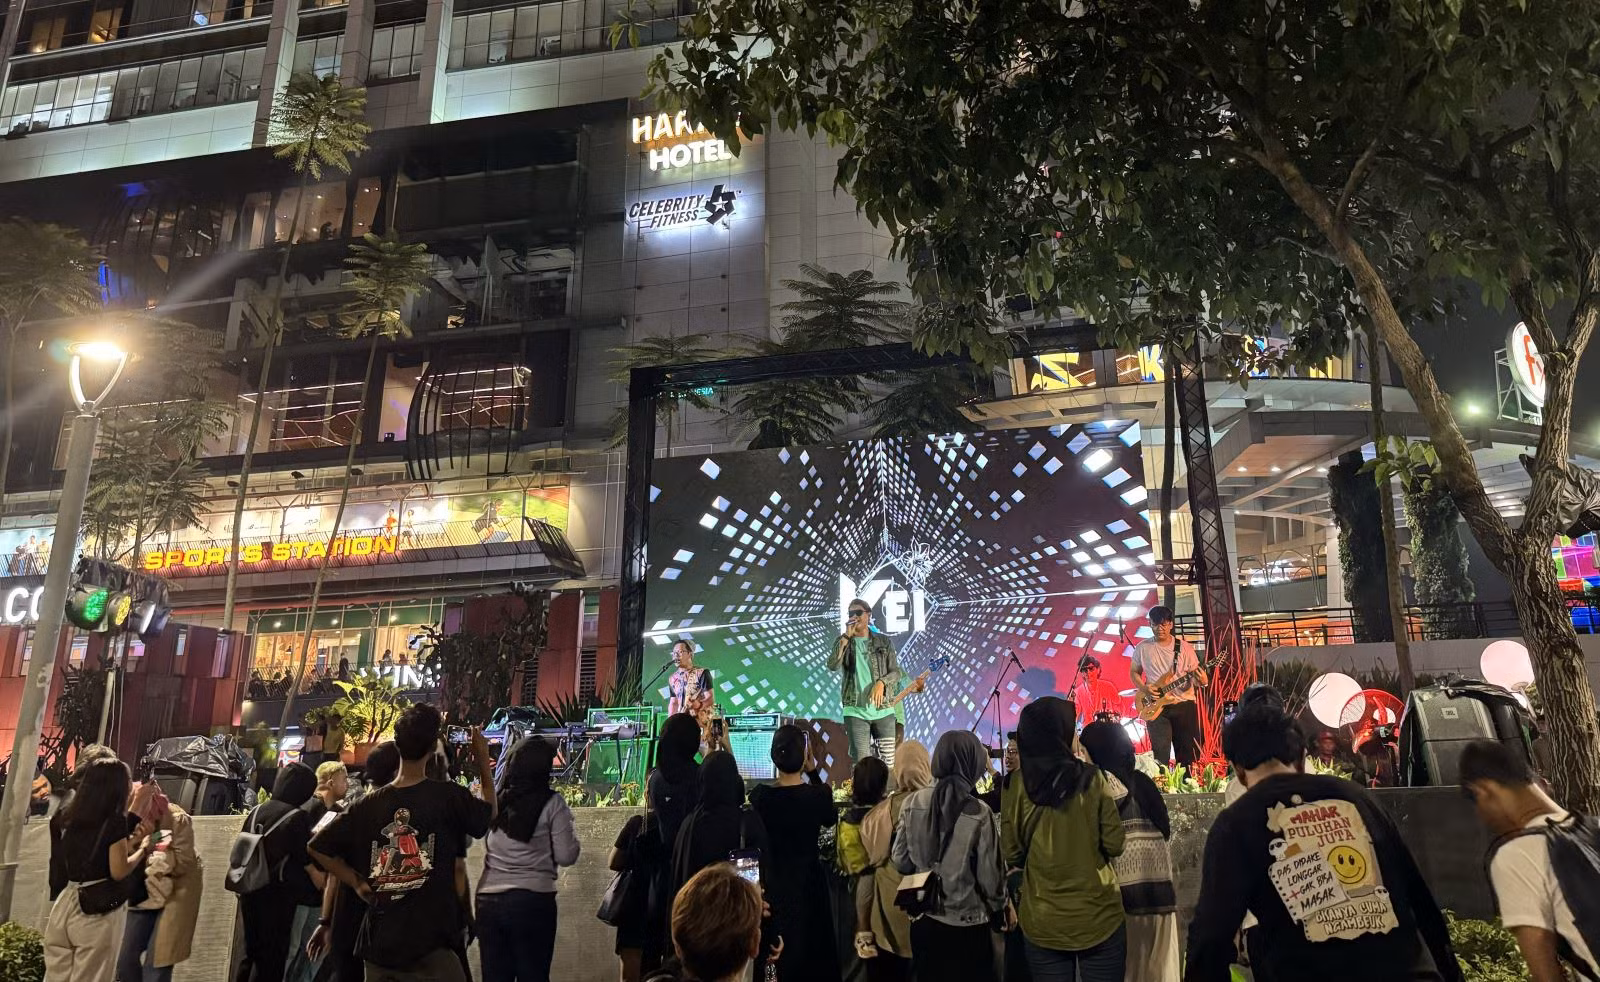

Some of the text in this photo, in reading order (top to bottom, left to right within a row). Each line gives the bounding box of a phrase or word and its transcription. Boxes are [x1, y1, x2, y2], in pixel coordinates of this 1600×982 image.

[650, 139, 732, 171] HOTEL
[629, 194, 704, 218] CELEBRITY
[650, 209, 699, 229] FITNESS
[1290, 805, 1341, 824] MAHAR
[1288, 817, 1352, 839] PULUHAN
[1317, 829, 1356, 847] JUTA
[1287, 863, 1322, 887] LONGGAR
[1316, 871, 1334, 887] BISA
[1300, 887, 1336, 912] MASAK
[1315, 901, 1388, 923] BISANYA CUMA
[1323, 915, 1386, 935] NGAMBEUK
